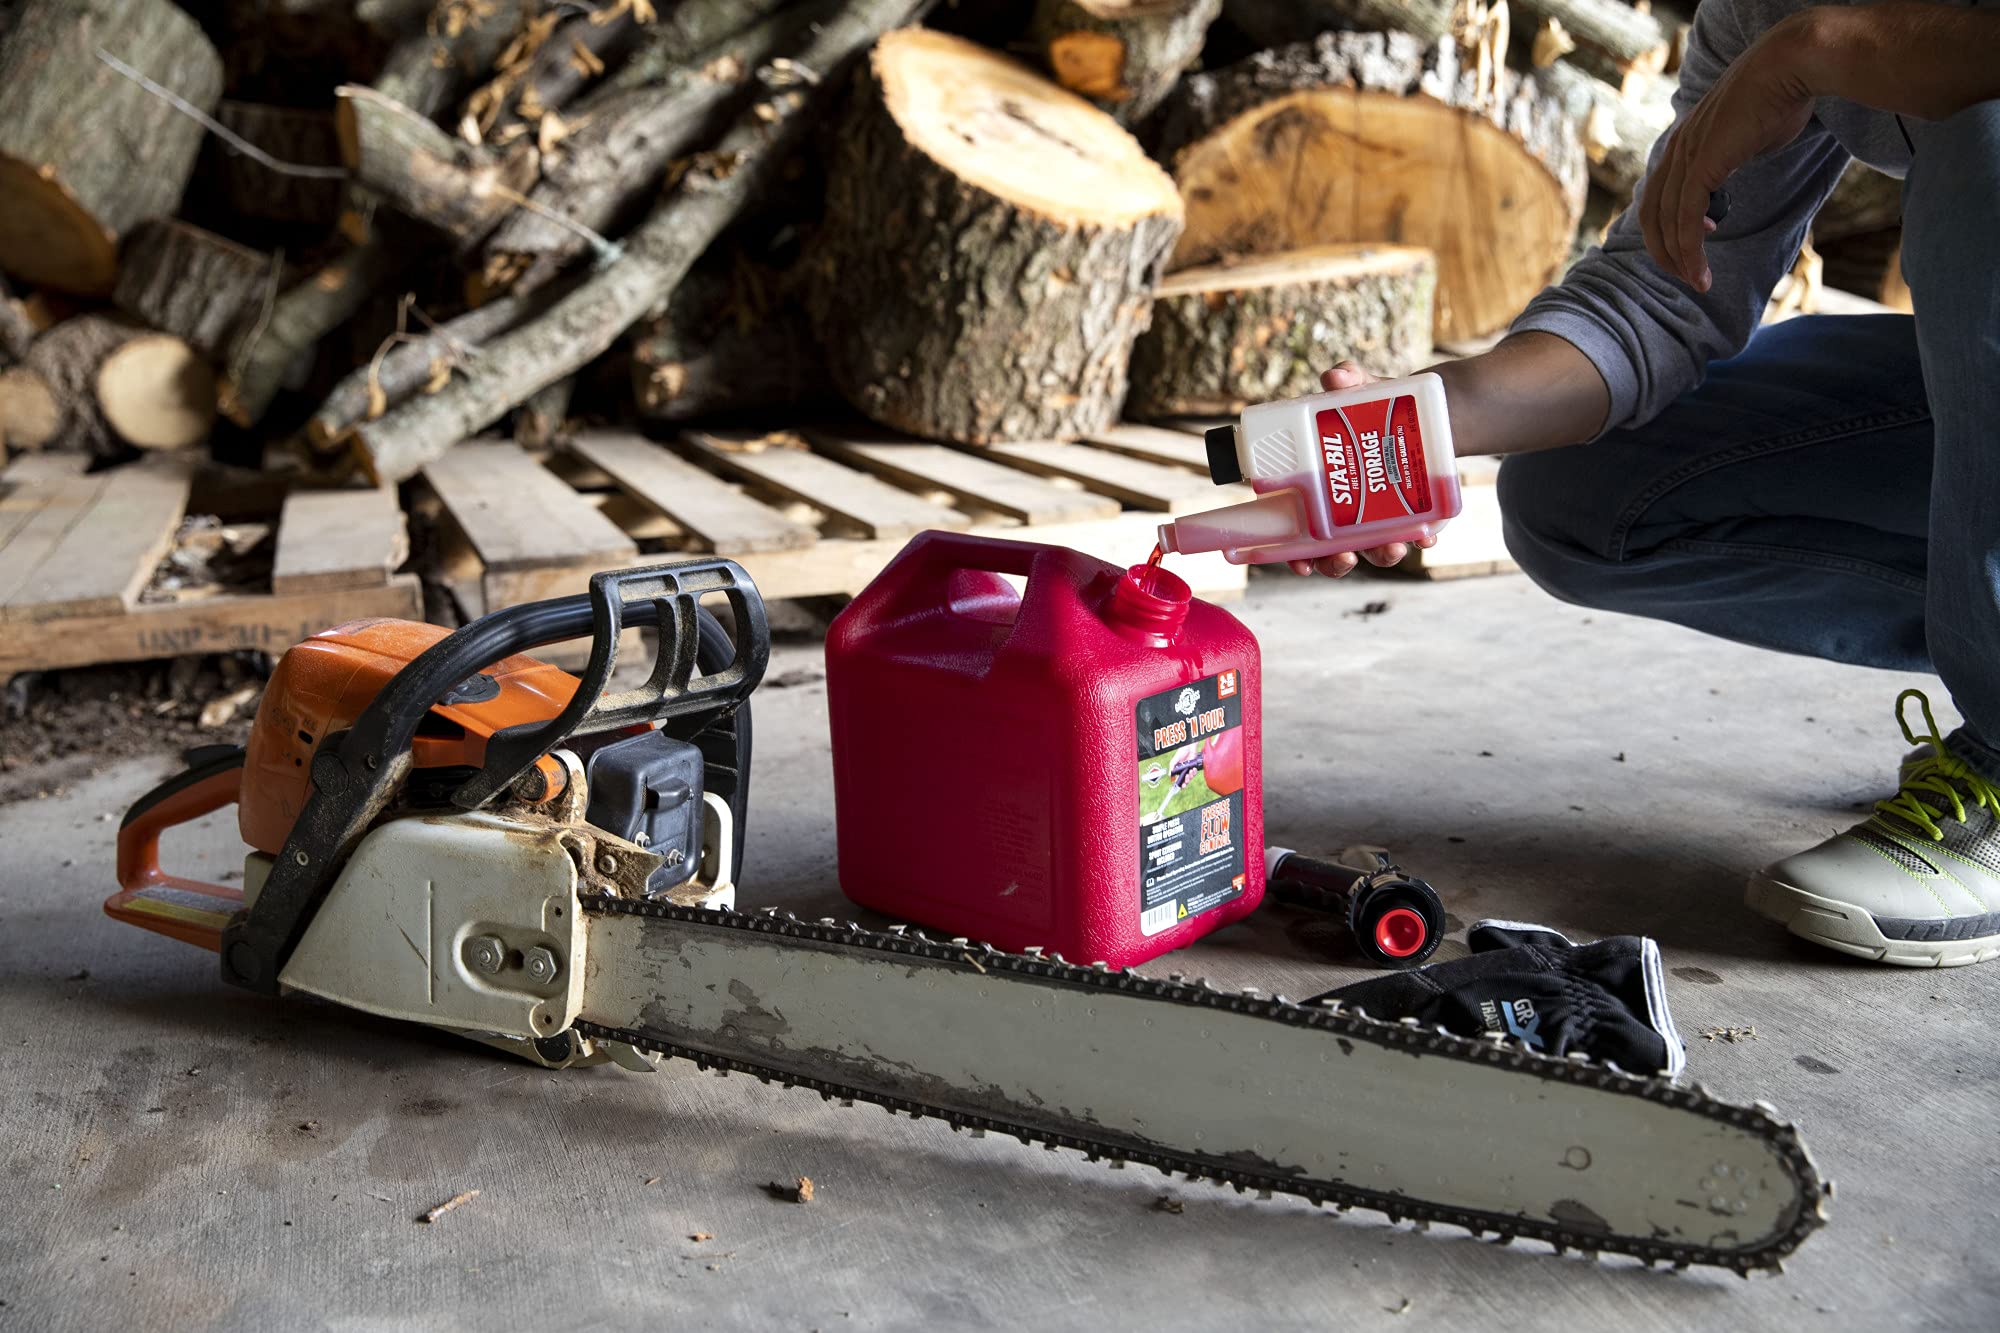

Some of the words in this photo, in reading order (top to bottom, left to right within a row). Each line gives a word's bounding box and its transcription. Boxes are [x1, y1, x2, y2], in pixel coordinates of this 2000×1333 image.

[1346, 445, 1357, 475] STABILIZER
[1397, 435, 1407, 457] GALLONS
[1323, 433, 1352, 505] STA-BIL
[1360, 430, 1386, 493] STORAGE
[1154, 720, 1187, 751] PRESS
[1199, 708, 1225, 735] POUR
[1202, 798, 1230, 822] PRECISE
[1201, 812, 1231, 841] FLOW
[1200, 831, 1231, 855] CONTROL
